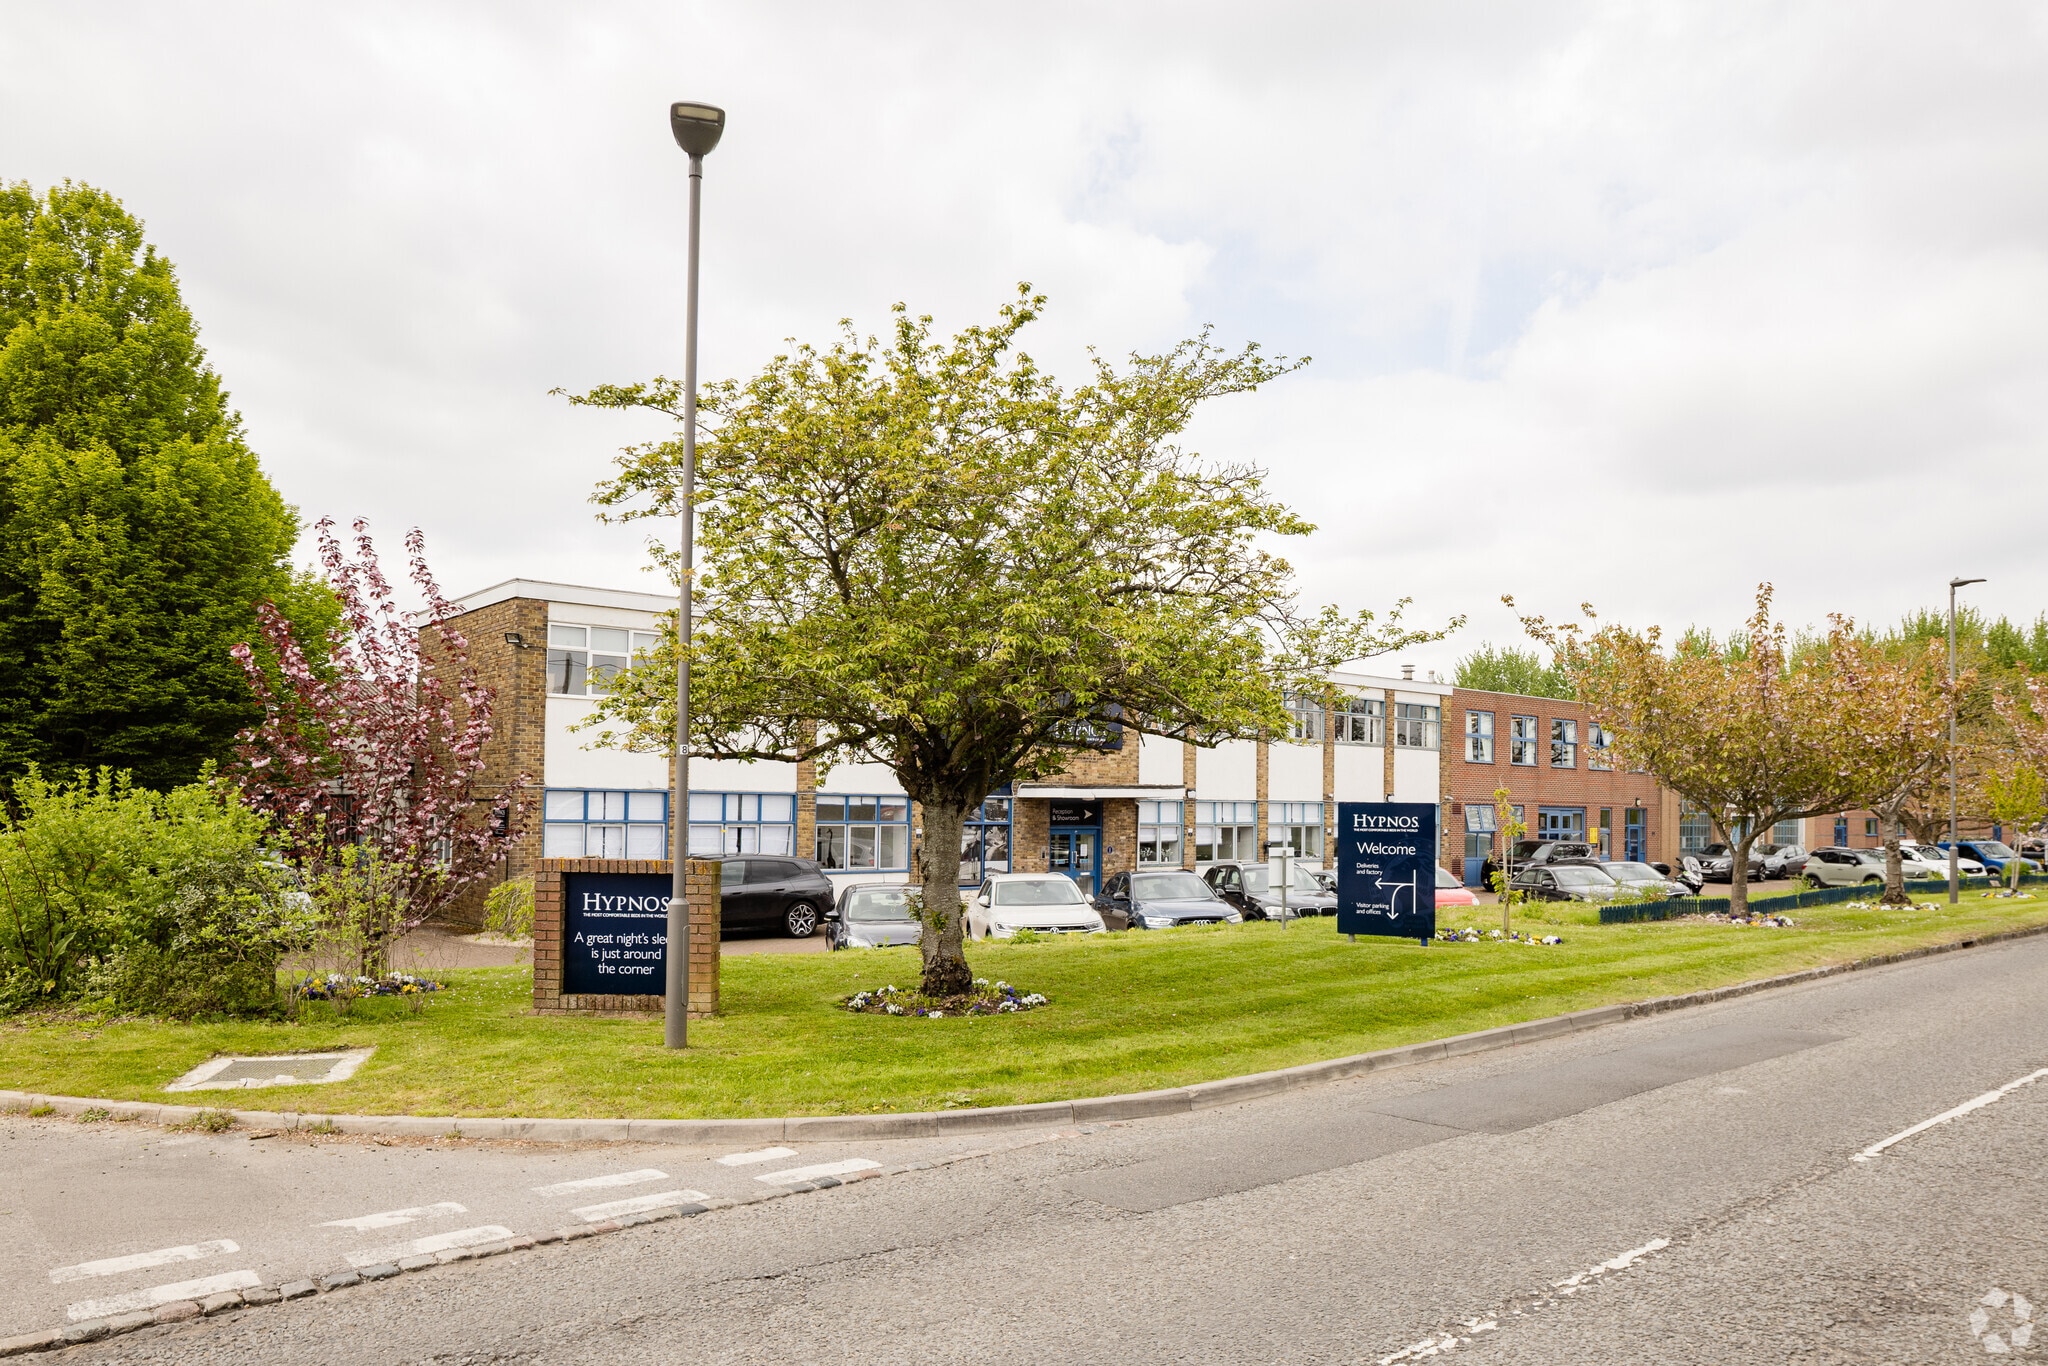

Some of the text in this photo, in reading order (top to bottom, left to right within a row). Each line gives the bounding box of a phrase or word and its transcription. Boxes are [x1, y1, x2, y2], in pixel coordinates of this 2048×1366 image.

[682, 745, 688, 753] 8
[1353, 814, 1419, 828] HYPNOS
[1356, 842, 1416, 855] Welcome
[582, 892, 670, 912] HYPNOS
[574, 932, 668, 946] A great night's sle
[592, 948, 662, 961] is just around
[598, 962, 654, 974] the corner
